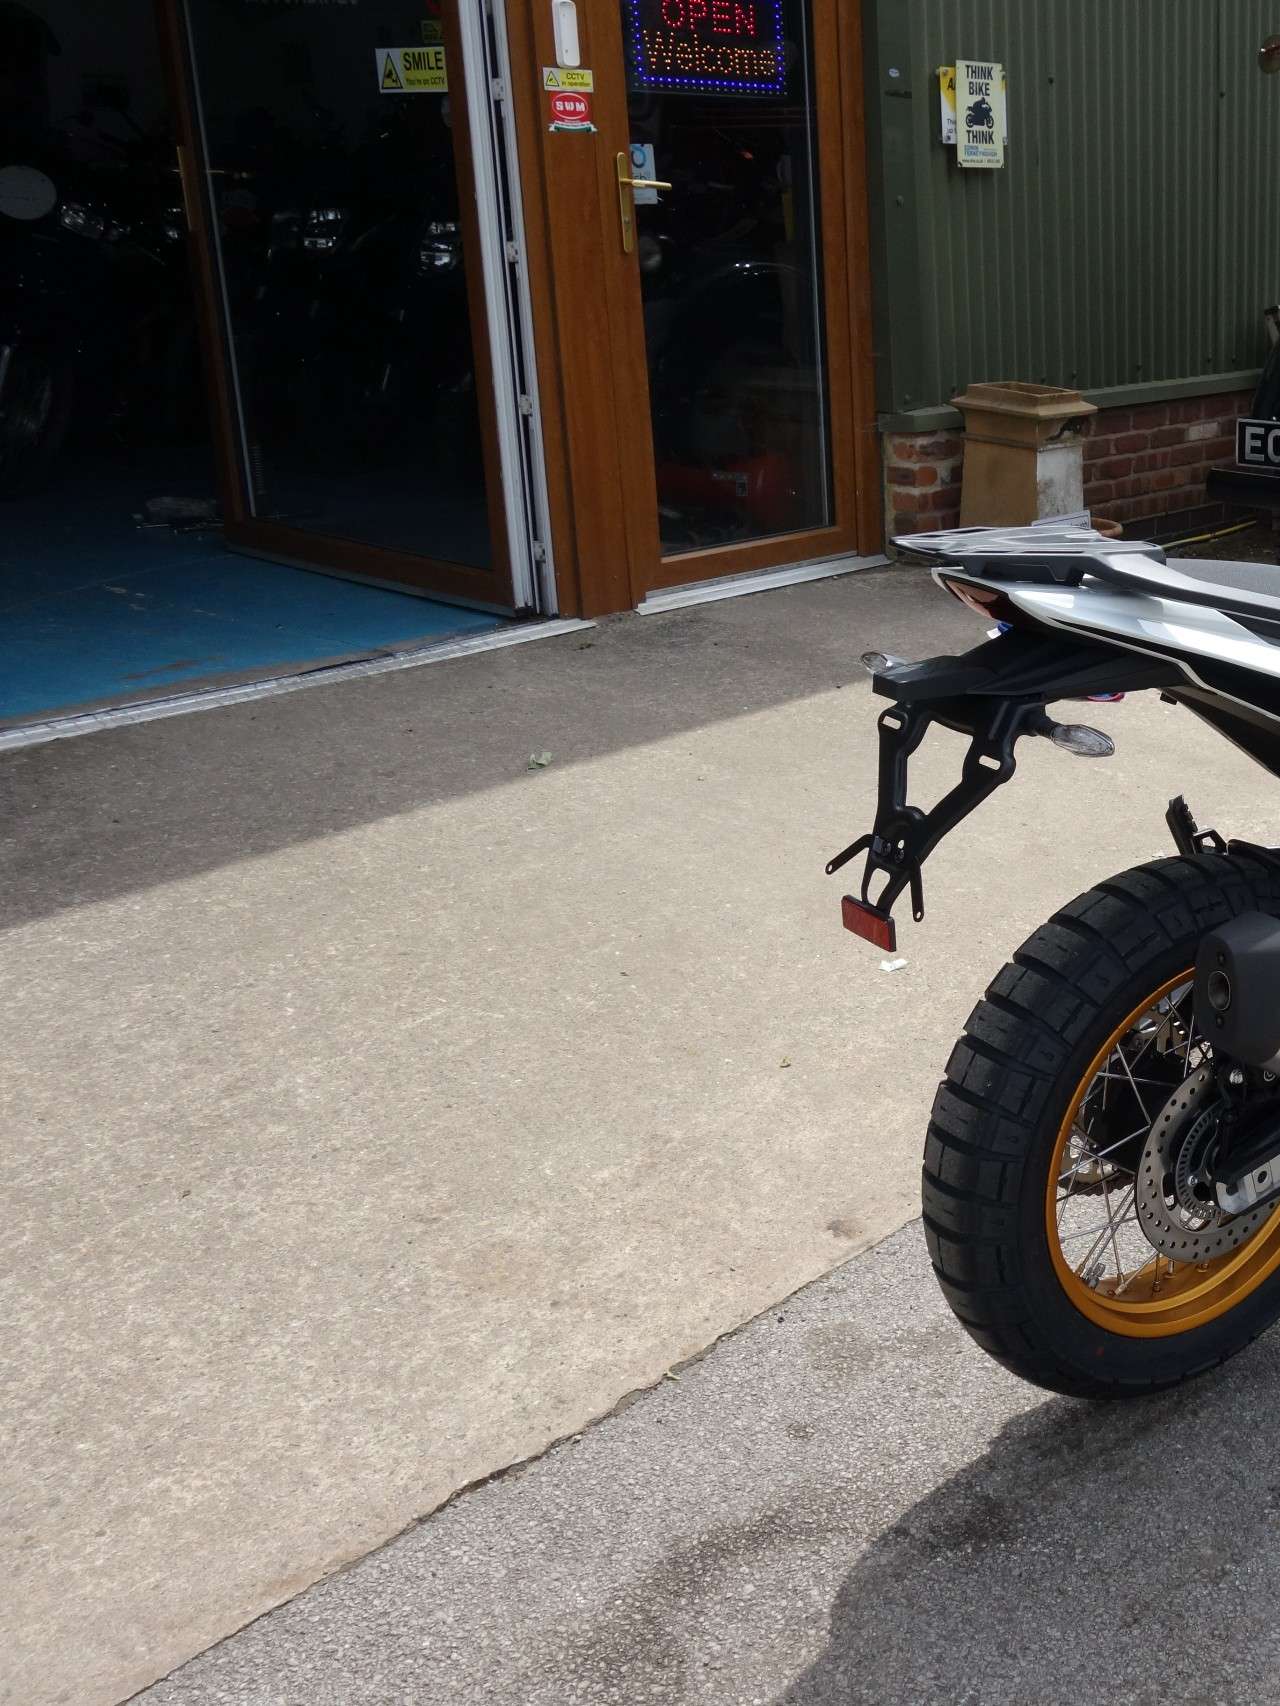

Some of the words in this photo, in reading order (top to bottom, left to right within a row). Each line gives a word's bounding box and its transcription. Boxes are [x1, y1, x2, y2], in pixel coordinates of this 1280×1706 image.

[661, 0, 756, 36] OPEN
[643, 29, 776, 76] Welcome
[403, 51, 443, 71] SMILE
[566, 72, 585, 80] CCTV
[966, 65, 993, 80] THINK
[969, 82, 990, 96] BIKE
[966, 130, 995, 144] THINK
